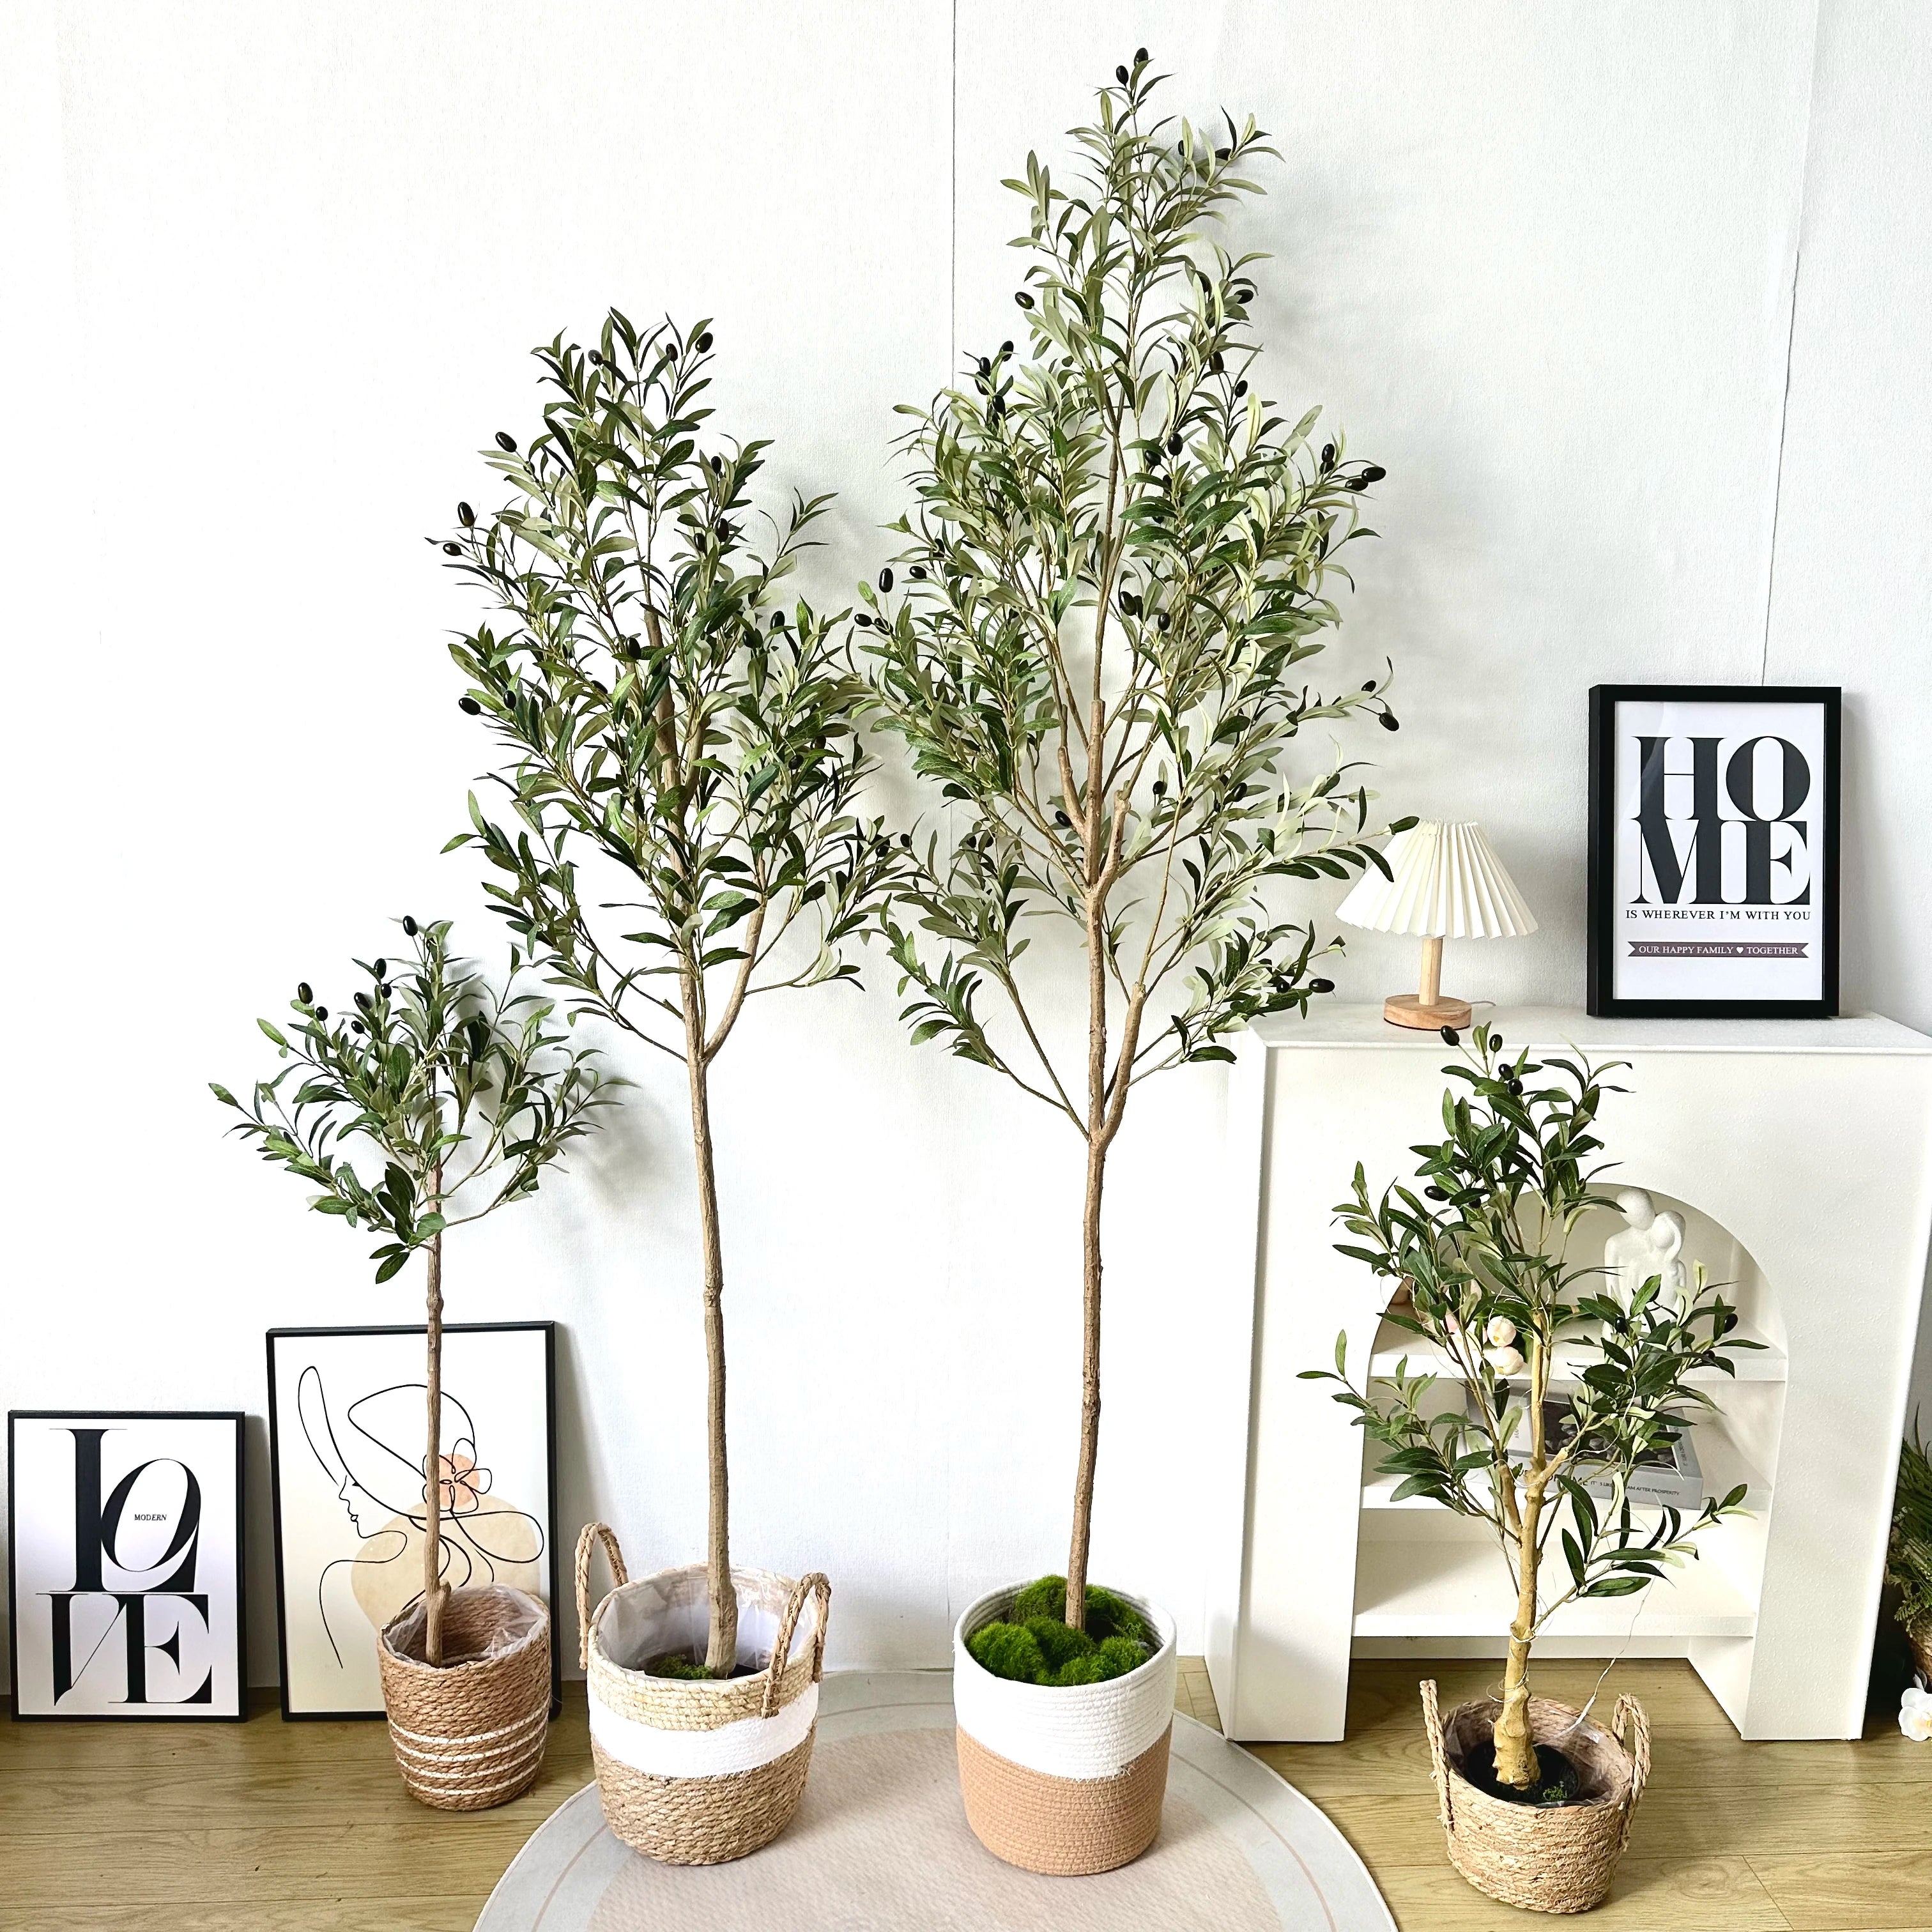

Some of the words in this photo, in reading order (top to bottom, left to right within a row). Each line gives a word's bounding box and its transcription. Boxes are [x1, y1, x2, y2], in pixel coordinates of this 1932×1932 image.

[1626, 910, 1637, 919] IS
[1642, 910, 1715, 919] WHEREVER
[1720, 910, 1740, 919] I'M
[1745, 911, 1779, 920] WITH
[1783, 911, 1811, 921] YOU
[1639, 946, 1660, 954] OUR
[1697, 946, 1734, 954] FAMILY
